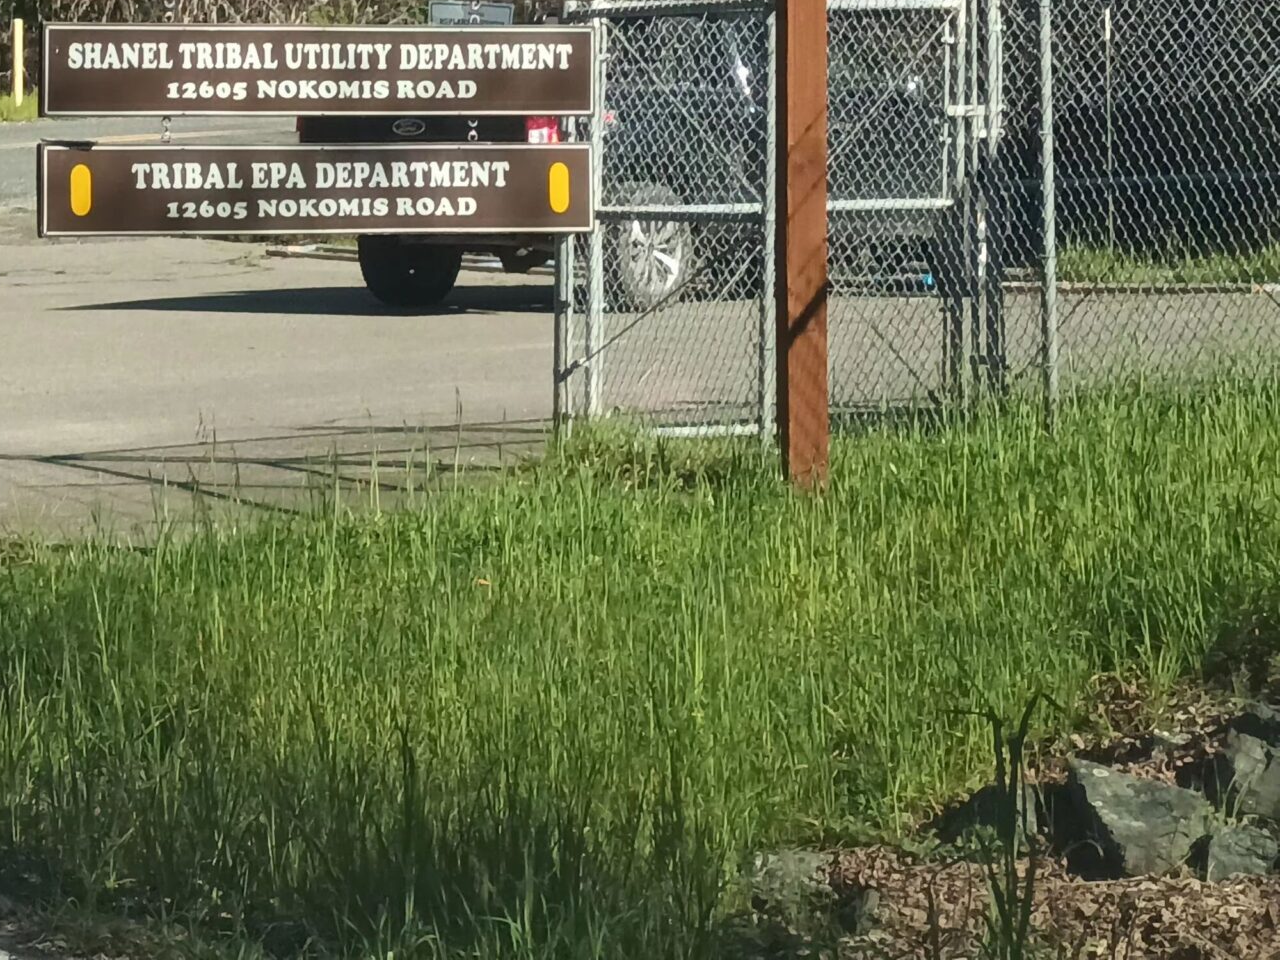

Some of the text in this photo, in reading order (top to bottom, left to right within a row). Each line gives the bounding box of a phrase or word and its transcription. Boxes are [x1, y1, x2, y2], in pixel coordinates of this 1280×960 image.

[67, 42, 573, 70] SHANEL TRIBAL UTILITY DEPARTMENT
[167, 79, 477, 101] 12605 NOKOMIS ROAD
[131, 161, 510, 190] TRIBAL EPA DEPARTMENT
[167, 196, 477, 220] 12605 NOKOMIS ROAD
